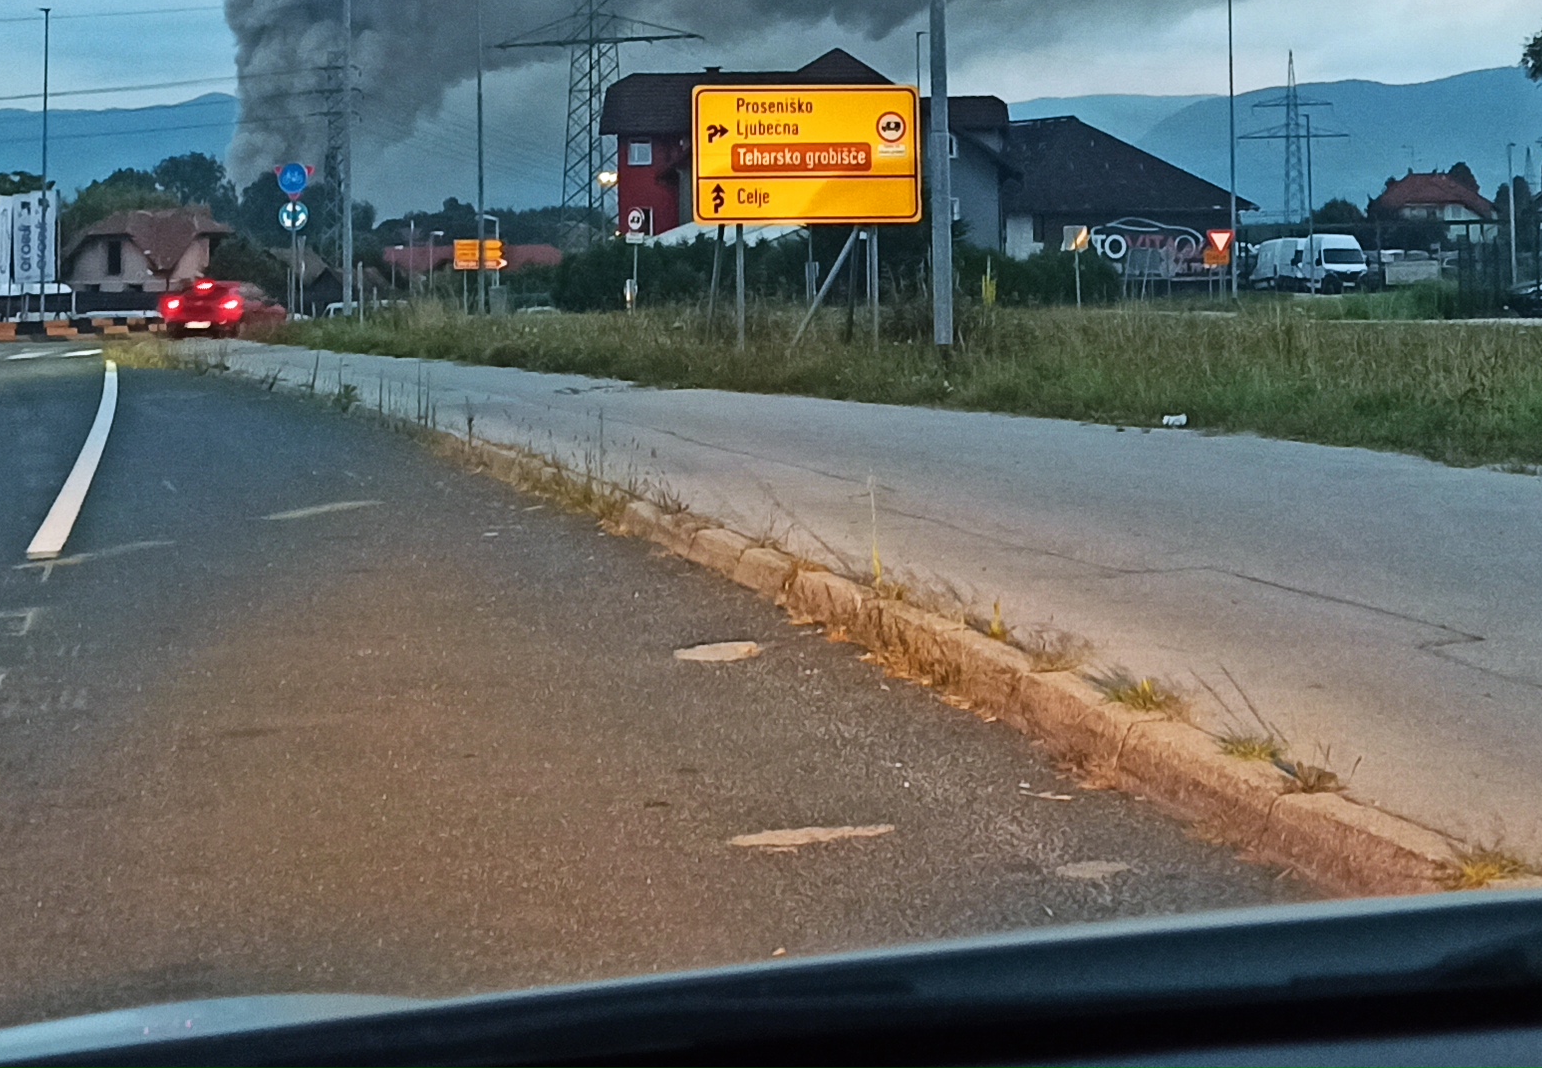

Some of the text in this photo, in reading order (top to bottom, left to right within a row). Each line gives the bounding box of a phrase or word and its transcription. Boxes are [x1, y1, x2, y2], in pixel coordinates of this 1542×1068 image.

[736, 96, 813, 113] Proseniško
[736, 119, 799, 139] Ljubečna
[737, 148, 801, 166] Teharsko
[805, 147, 866, 169] grobišče
[737, 188, 770, 208] Celje
